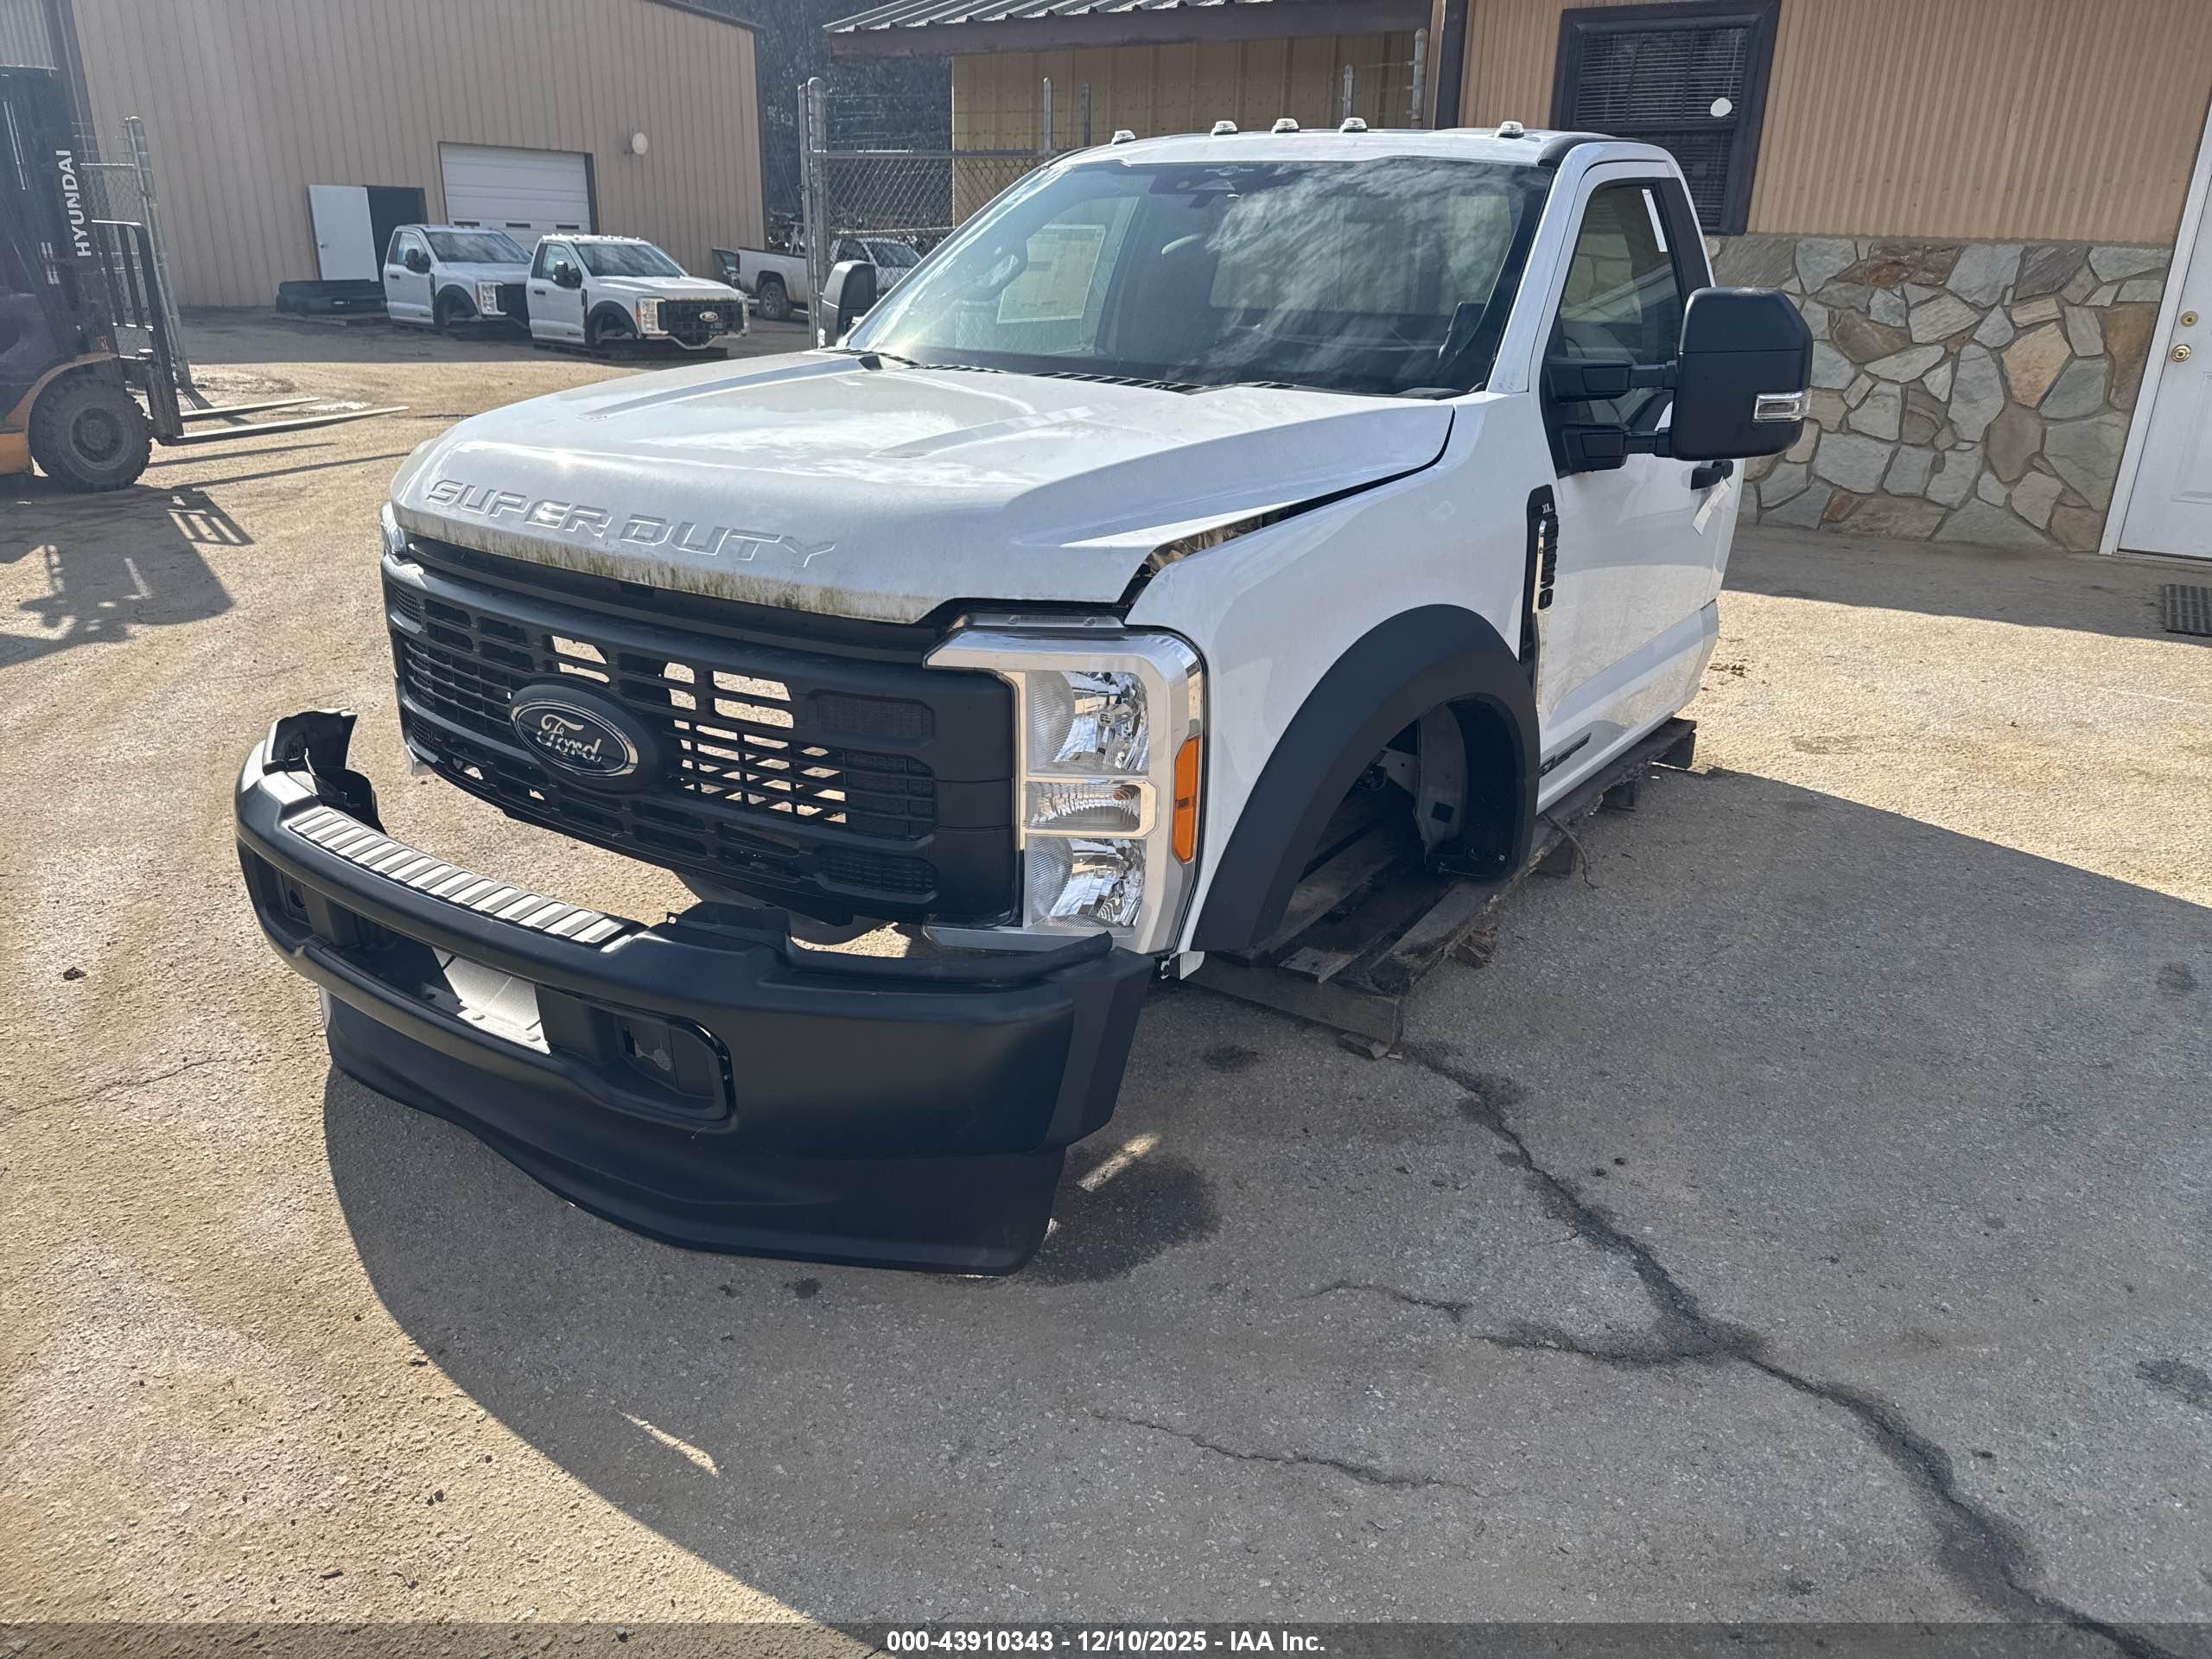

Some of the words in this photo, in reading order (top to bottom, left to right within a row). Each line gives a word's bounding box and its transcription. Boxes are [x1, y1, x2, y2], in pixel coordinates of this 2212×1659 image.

[55, 149, 92, 257] HYUNDAI
[425, 479, 613, 538] SUPER
[619, 513, 836, 568] DUTY
[1541, 503, 1554, 514] XL
[536, 714, 602, 763] Ford
